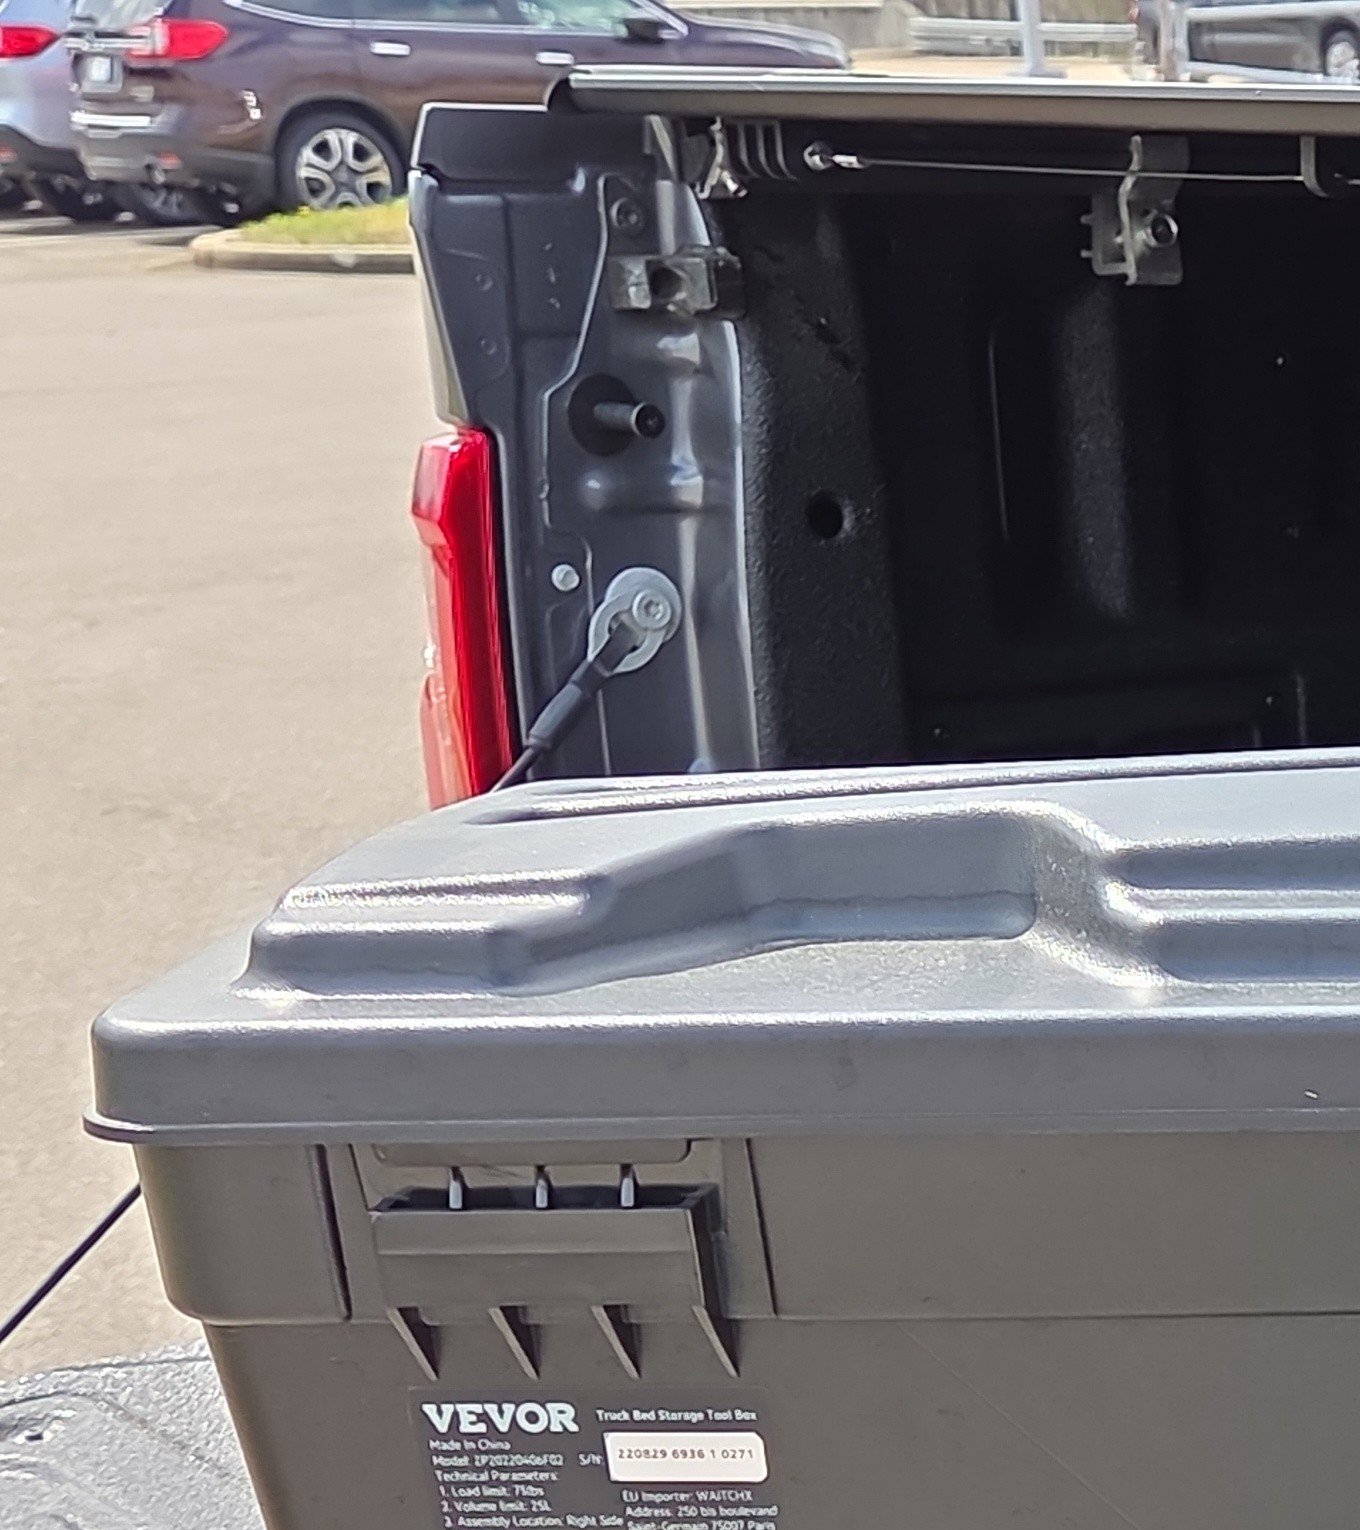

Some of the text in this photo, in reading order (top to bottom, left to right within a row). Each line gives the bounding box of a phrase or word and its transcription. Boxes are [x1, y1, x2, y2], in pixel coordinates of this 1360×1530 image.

[422, 1402, 579, 1433] VEVOR
[596, 1410, 758, 1423] Truck Bed Storage Tool Box
[429, 1440, 461, 1450] Made
[478, 1440, 511, 1451] China
[618, 1449, 754, 1459] 220829 6936 1 0271
[436, 1471, 488, 1481] Technical
[451, 1486, 480, 1496] Load
[621, 1490, 638, 1501] EU
[455, 1501, 497, 1512] Volume
[677, 1506, 698, 1516] 250
[458, 1517, 510, 1528] Assembly
[566, 1515, 597, 1528] Right
[600, 1516, 623, 1526] Side
[748, 1521, 776, 1530] Paris
